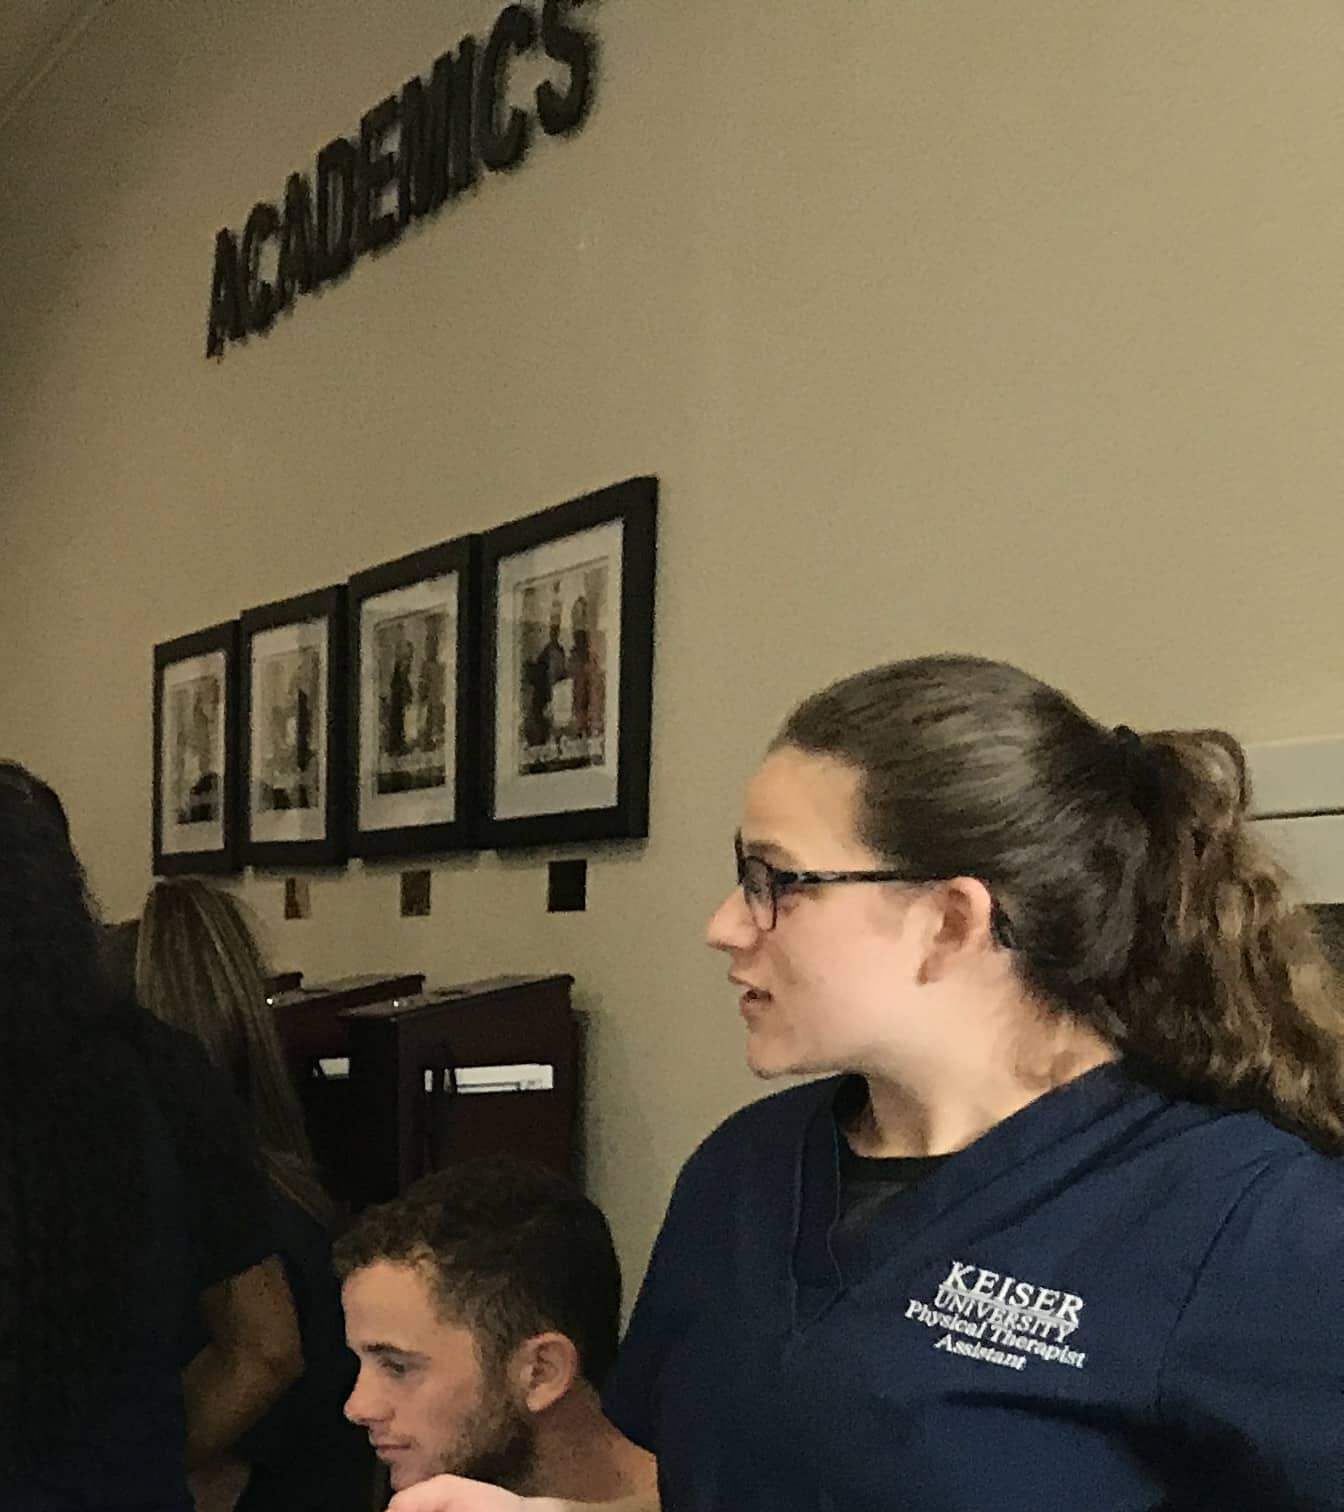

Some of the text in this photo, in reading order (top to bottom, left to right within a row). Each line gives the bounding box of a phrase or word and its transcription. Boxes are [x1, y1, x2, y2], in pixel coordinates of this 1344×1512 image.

[207, 0, 594, 360] ACADEMICS
[934, 1288, 1078, 1342] UNIVERSITY
[944, 1260, 1084, 1325] KEISER
[905, 1299, 1088, 1369] Physical Therapist
[934, 1333, 1028, 1371] Assistant
